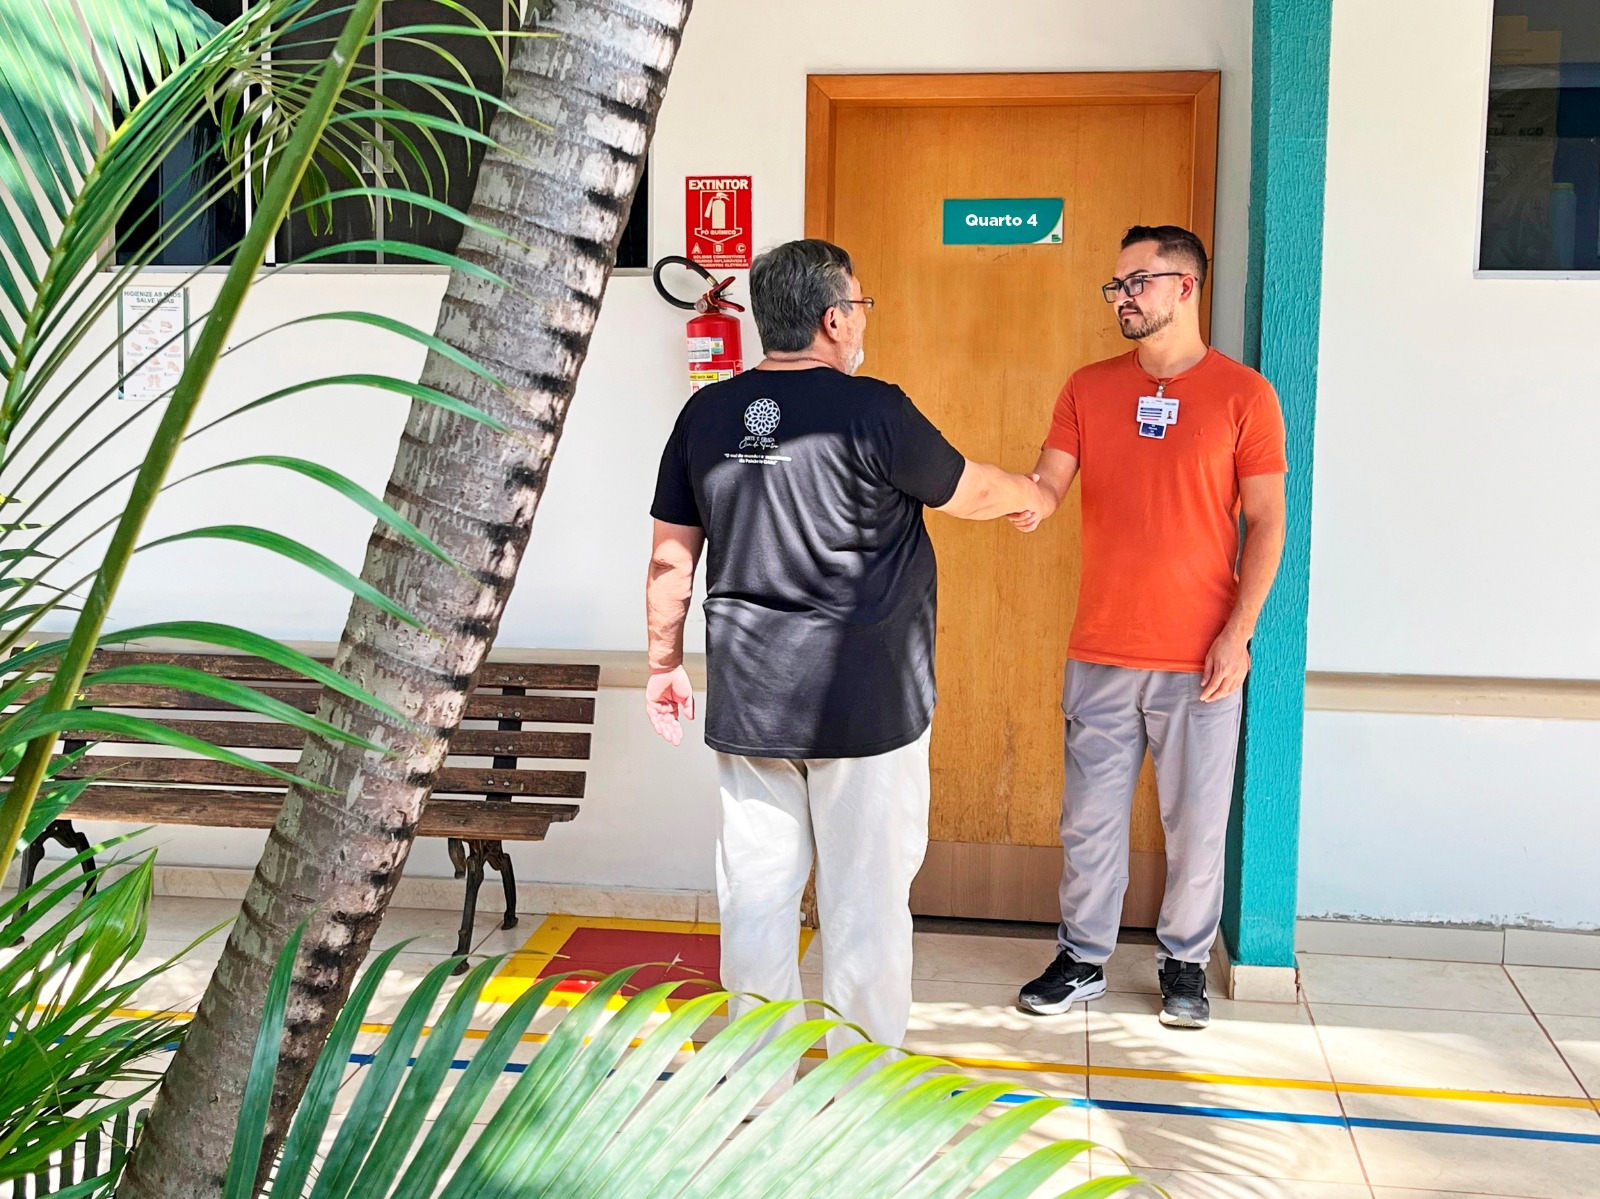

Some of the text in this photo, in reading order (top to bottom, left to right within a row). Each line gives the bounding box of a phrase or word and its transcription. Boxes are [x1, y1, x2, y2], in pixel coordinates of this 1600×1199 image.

[688, 179, 748, 190] EXTINTOR
[965, 214, 1038, 226] Quarto 4
